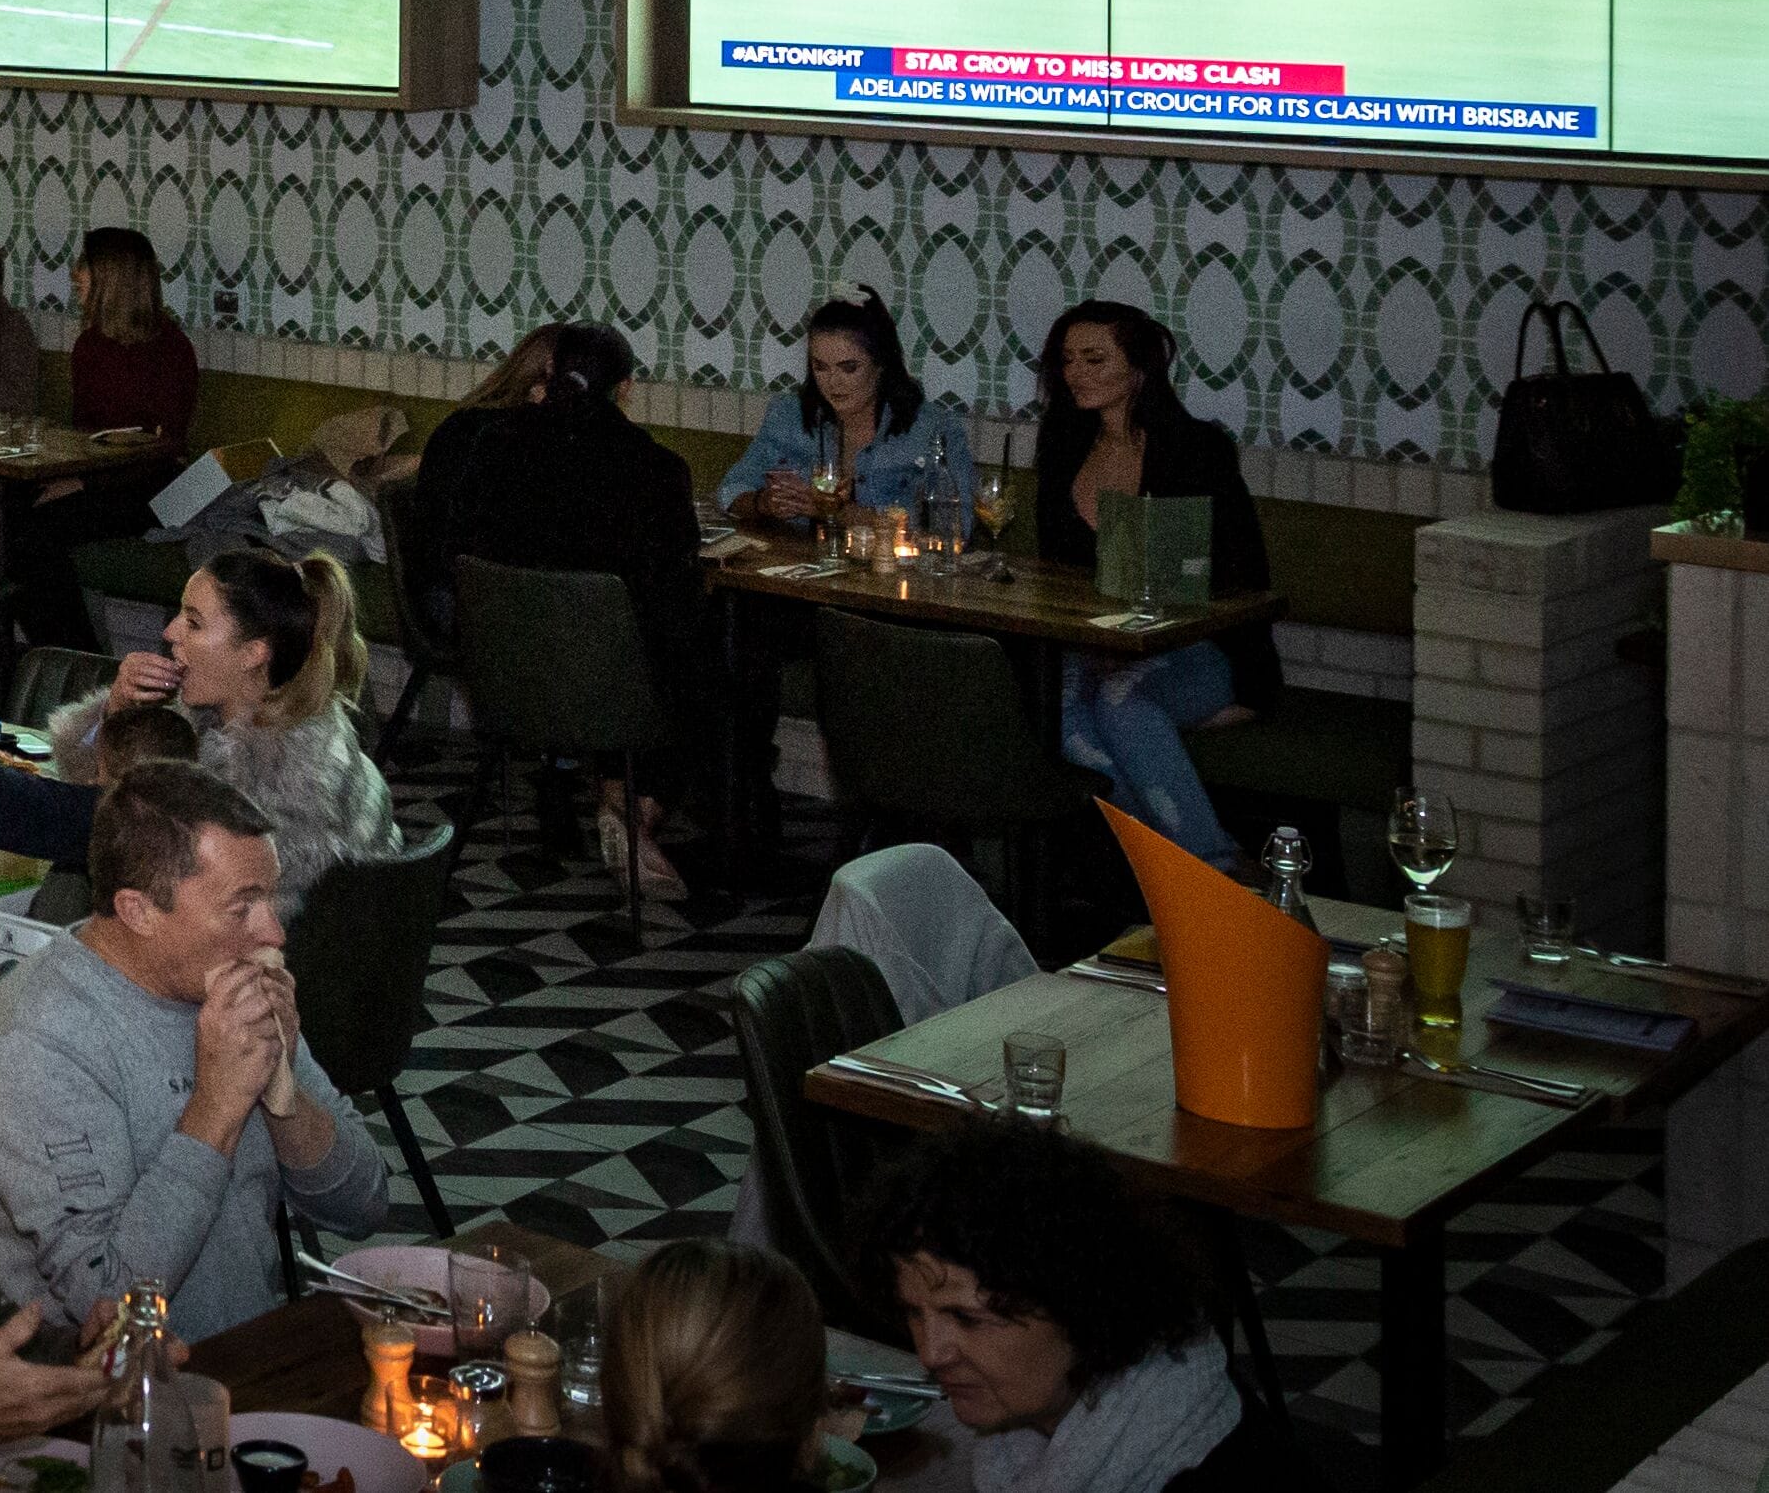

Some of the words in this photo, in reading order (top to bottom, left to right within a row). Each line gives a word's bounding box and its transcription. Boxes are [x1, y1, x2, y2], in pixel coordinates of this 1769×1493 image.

[731, 45, 864, 68] #AFLTONIGHT
[905, 52, 958, 72] STAR
[963, 54, 1029, 75] CROW
[1035, 57, 1066, 76] TO
[1072, 59, 1123, 79] MISS
[1130, 62, 1198, 82] LIONS
[1203, 64, 1281, 86] CLASH
[849, 77, 944, 99] ADELAIDE
[949, 82, 966, 101] IS
[970, 83, 1064, 105] WITHOUT
[1067, 87, 1124, 108] MATT
[1127, 91, 1221, 113] CROUCH
[1228, 96, 1273, 116] FOR
[1278, 98, 1310, 118] ITS
[1314, 99, 1391, 122] CLASH
[1396, 103, 1456, 124] WITH
[1462, 107, 1580, 131] BRISBANE
